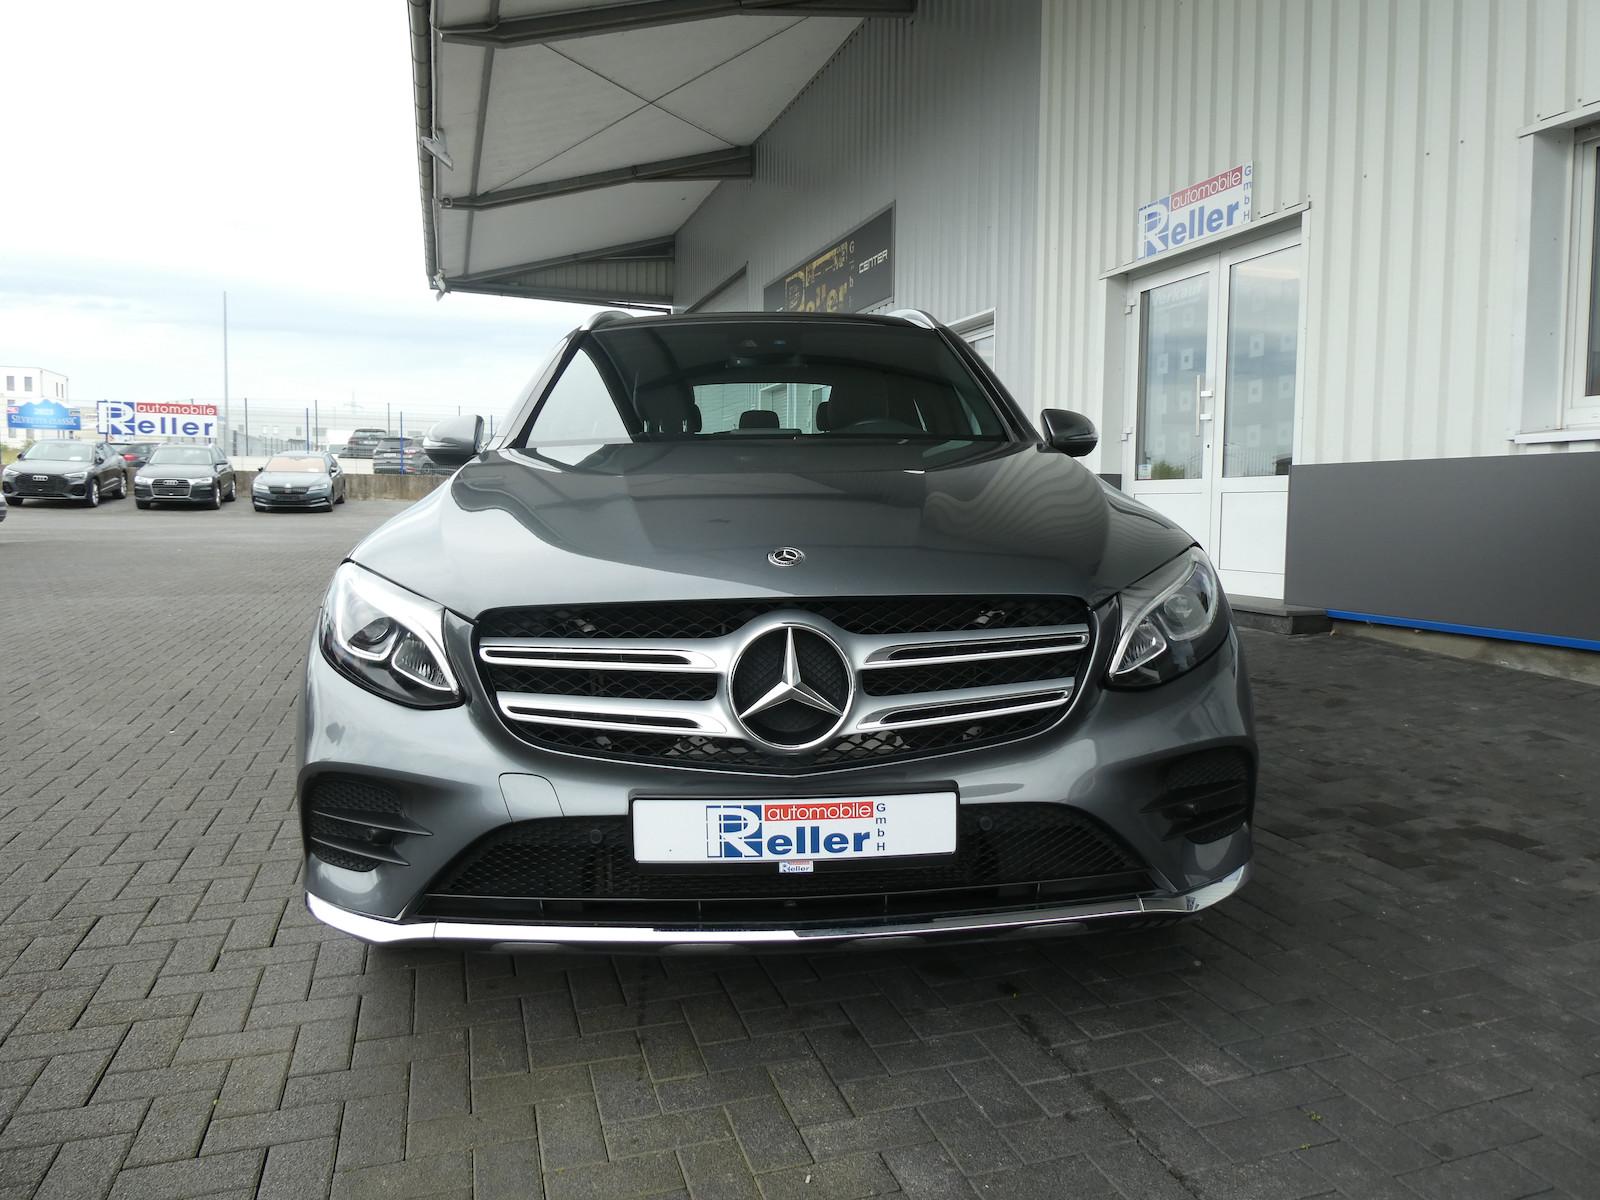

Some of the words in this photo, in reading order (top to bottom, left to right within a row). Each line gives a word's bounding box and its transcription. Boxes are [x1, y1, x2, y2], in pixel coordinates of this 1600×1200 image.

[1171, 170, 1241, 210] automobile
[1243, 165, 1252, 222] GmbH
[1137, 199, 1239, 260] Reller
[858, 248, 888, 274] CENTER
[97, 400, 213, 435] Reller
[137, 403, 215, 415] automobile
[706, 805, 871, 858] Reller
[767, 803, 872, 821] automobile
[876, 802, 887, 852] GmbH
